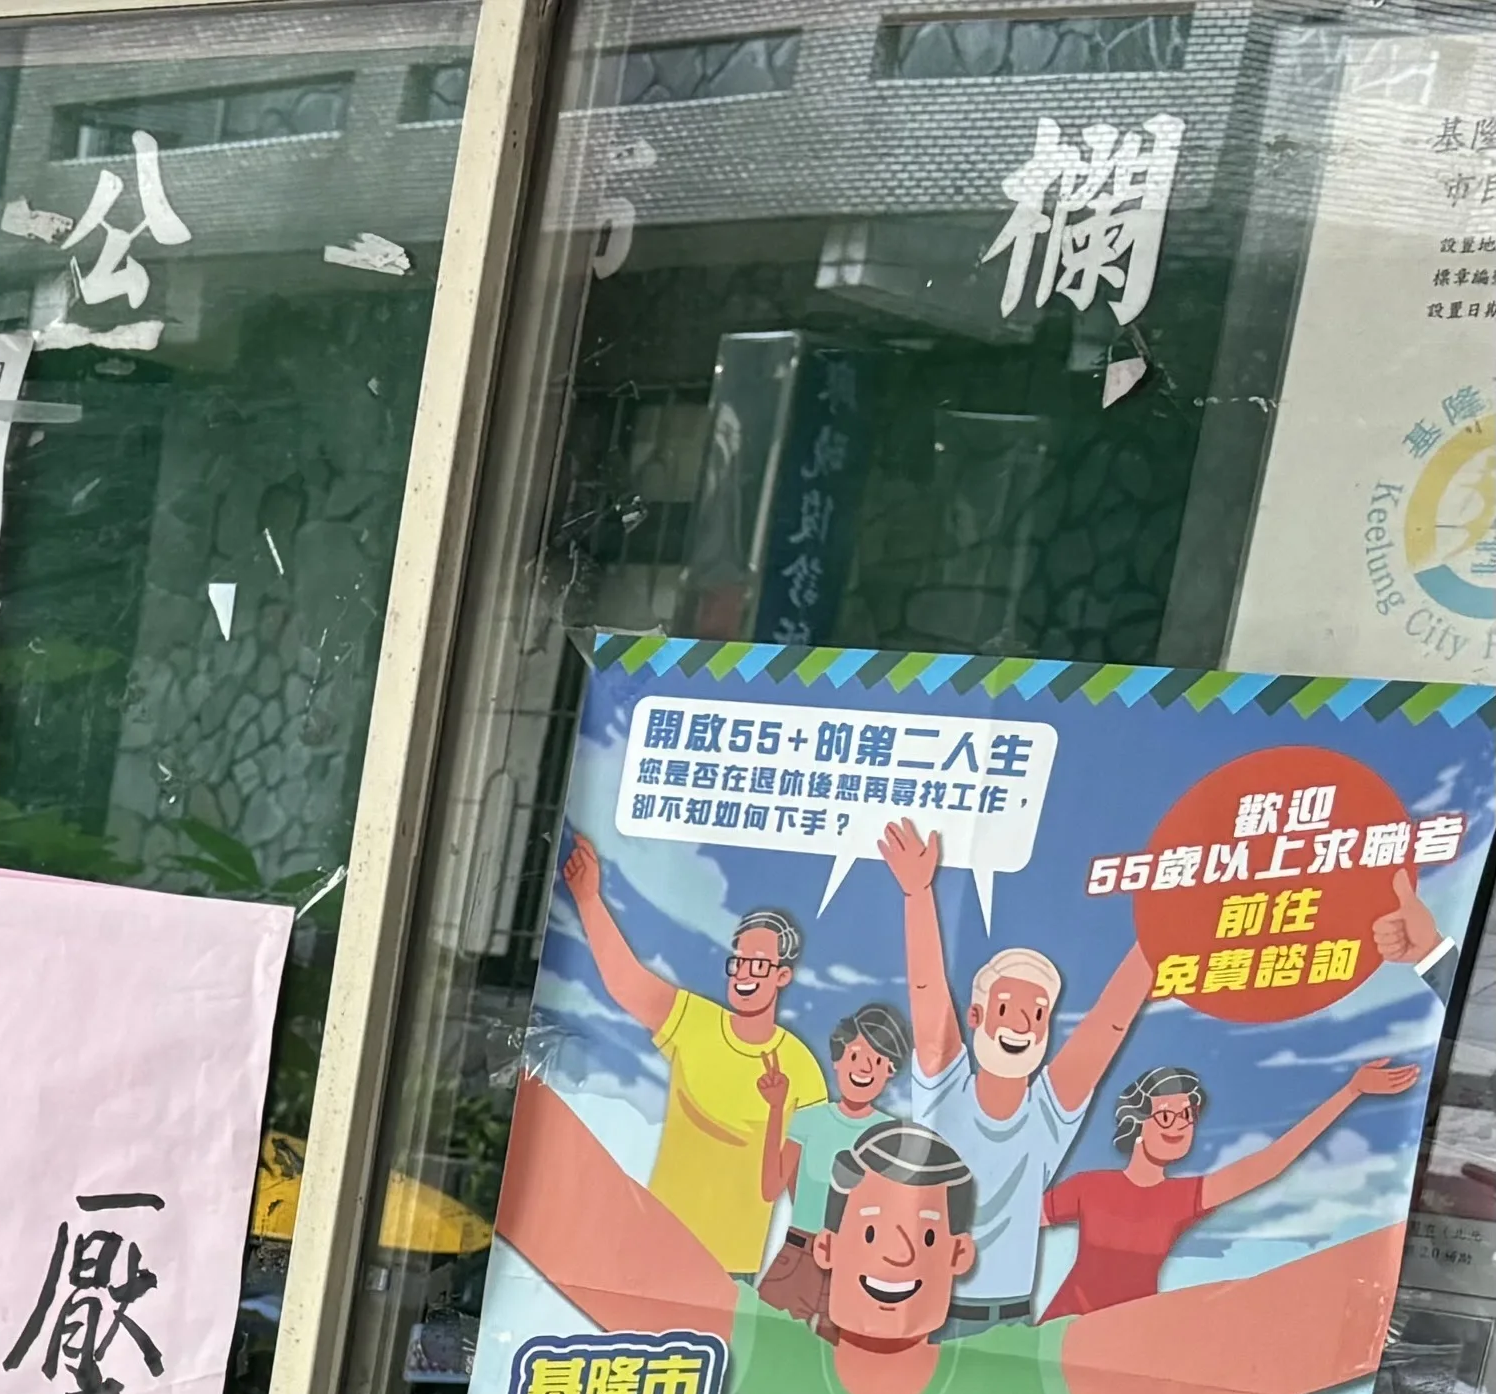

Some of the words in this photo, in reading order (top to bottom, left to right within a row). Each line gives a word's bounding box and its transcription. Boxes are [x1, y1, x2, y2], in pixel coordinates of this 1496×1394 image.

[59, 129, 193, 310] 公
[981, 113, 1186, 326] 欄
[1364, 479, 1406, 616] Keelung
[1405, 606, 1469, 661] City
[1233, 785, 1337, 838] 歡迎
[1087, 816, 1464, 895] 55歲以上求職者
[1215, 887, 1323, 939] 前往
[1151, 939, 1362, 998] 免費諮詢
